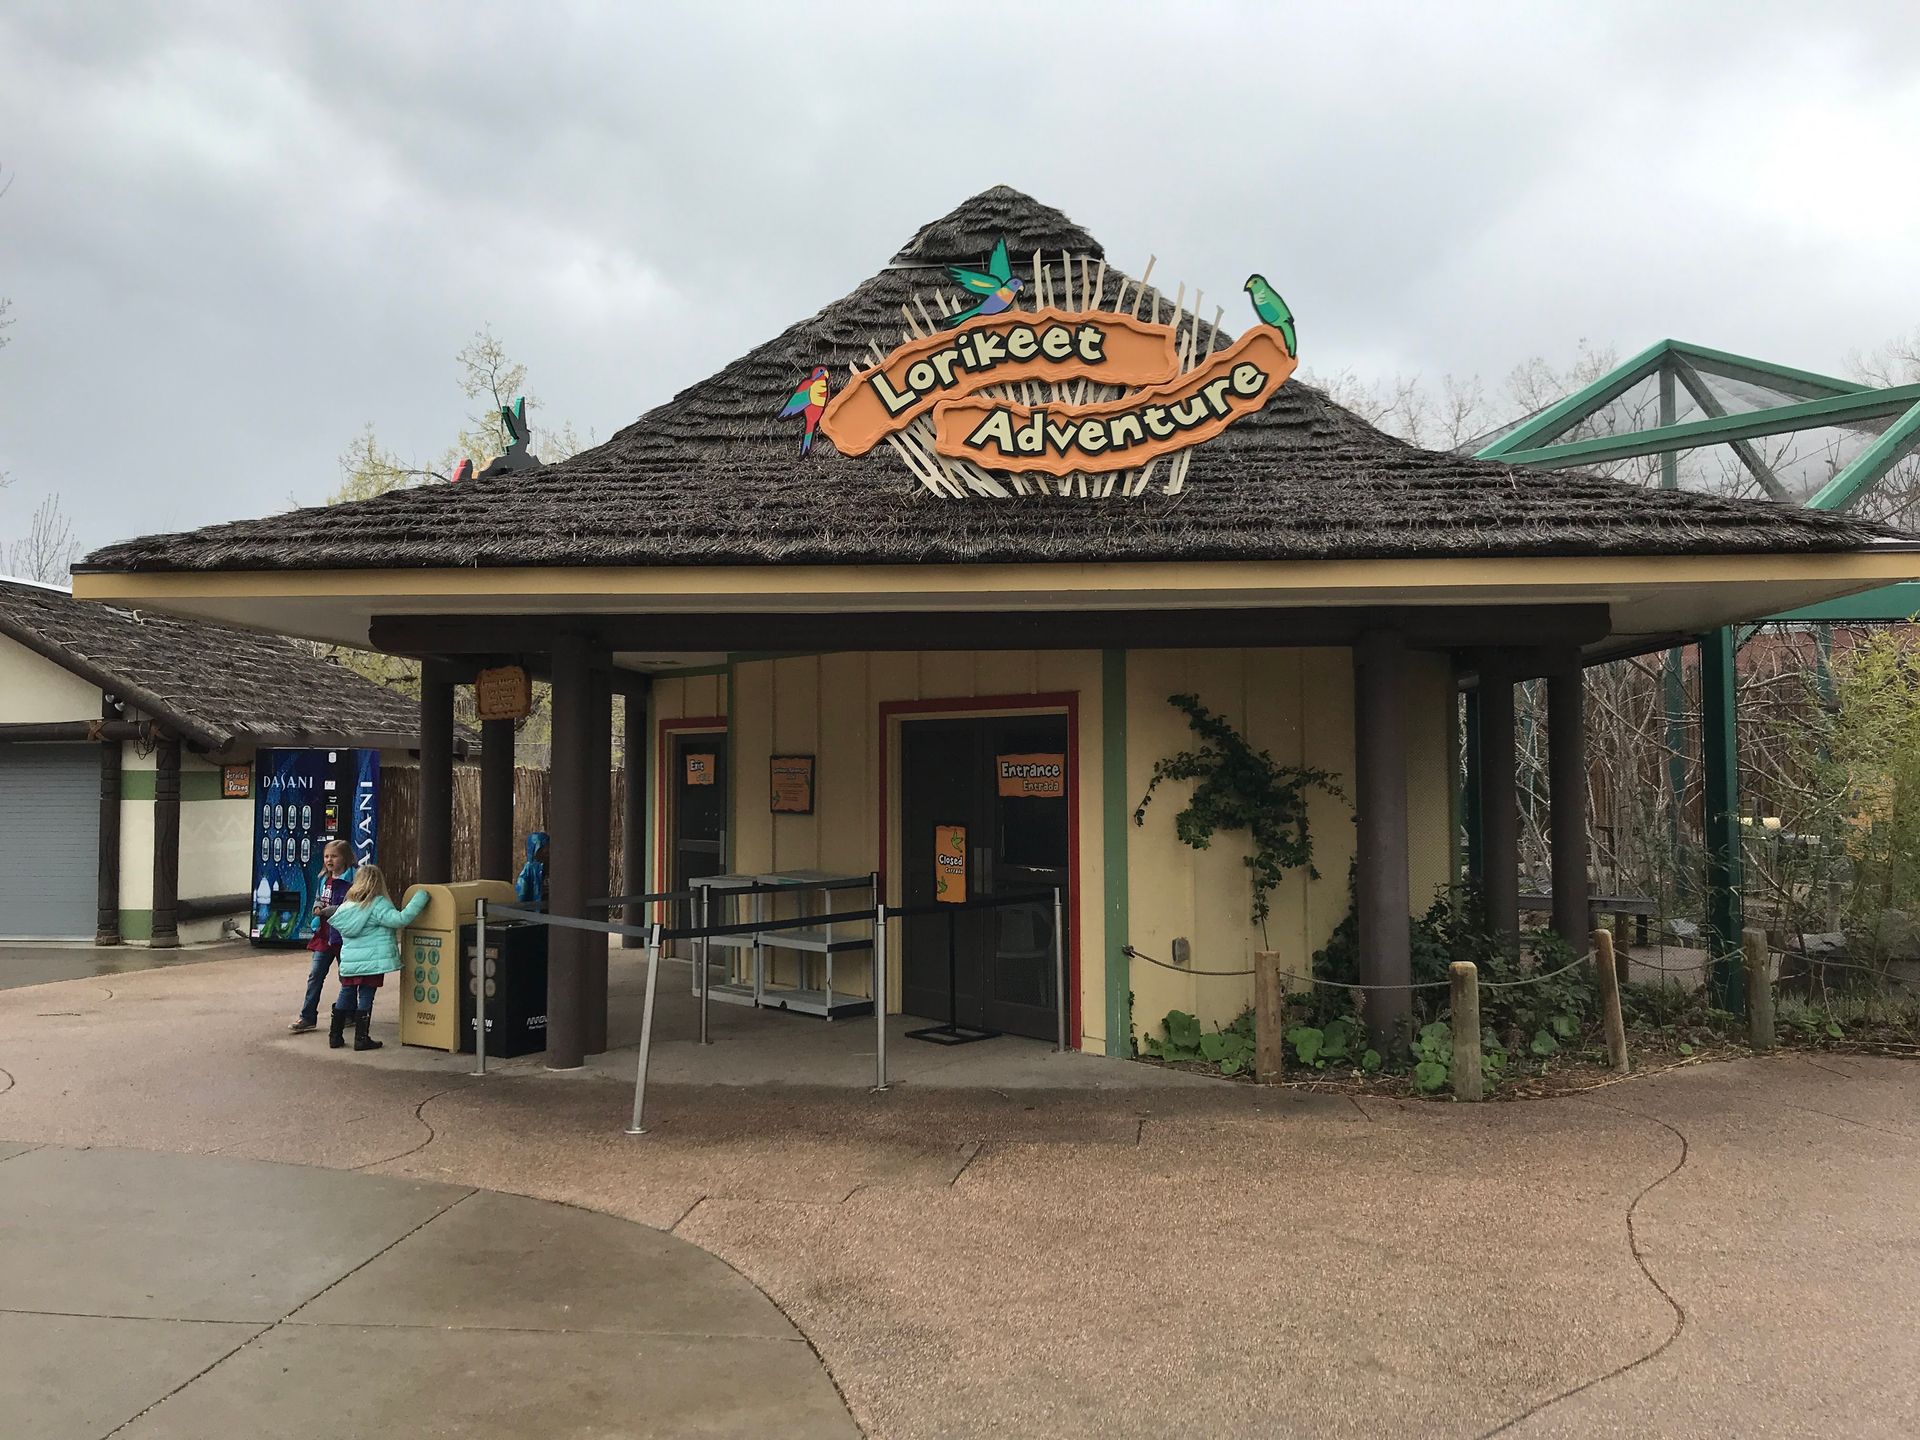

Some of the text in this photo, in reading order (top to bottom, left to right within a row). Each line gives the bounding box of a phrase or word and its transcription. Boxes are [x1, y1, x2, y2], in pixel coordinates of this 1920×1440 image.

[867, 322, 1107, 417] Lorikeet
[964, 361, 1268, 457] Adventure
[690, 760, 704, 771] Exit
[1001, 762, 1060, 778] Entrance
[263, 771, 313, 791] DASANI
[1023, 780, 1059, 791] Entrada
[355, 781, 374, 867] ASANI
[938, 854, 963, 866] Closed
[414, 937, 441, 947] COMPOST
